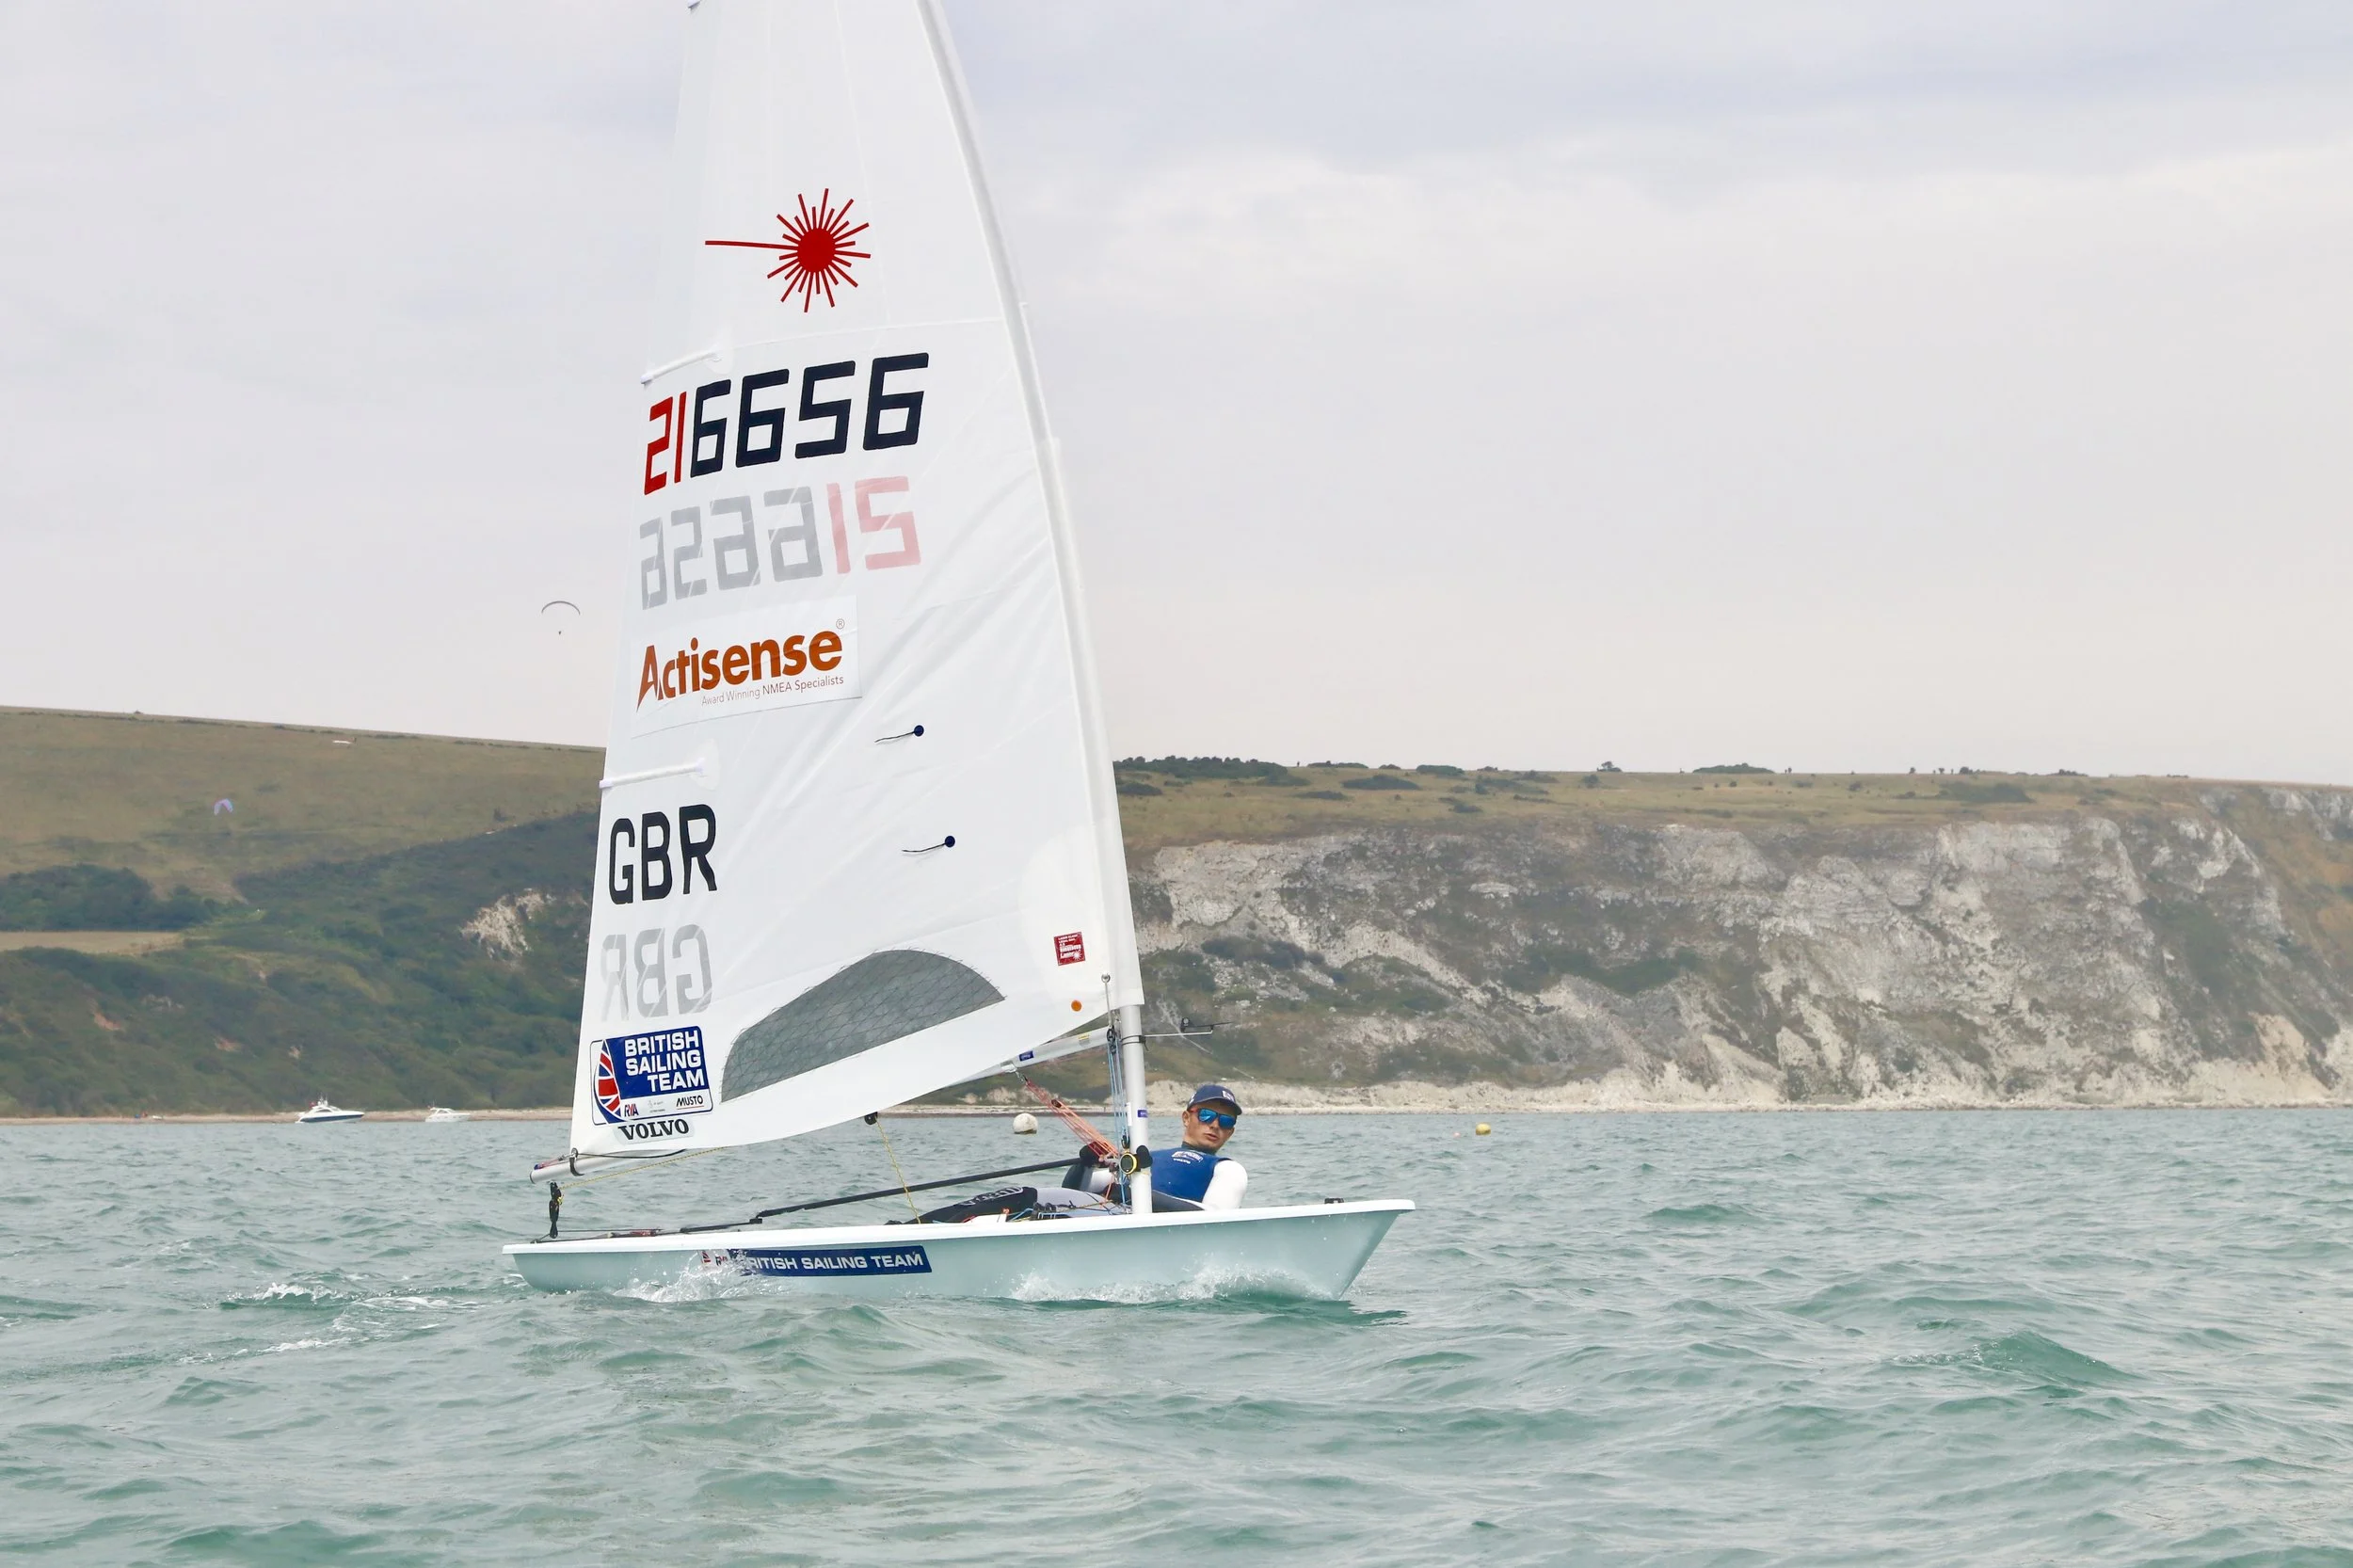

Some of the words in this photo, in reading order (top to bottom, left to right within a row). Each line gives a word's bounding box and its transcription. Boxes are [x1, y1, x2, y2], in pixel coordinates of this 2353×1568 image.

[644, 352, 929, 495] 216656
[701, 693, 725, 706] Award
[726, 688, 760, 701] Winning
[762, 681, 792, 695] NMEA
[794, 676, 844, 693] Specialists
[608, 803, 717, 904] GBR
[624, 1030, 699, 1057] BRITISH
[625, 1049, 700, 1077] SAILING
[647, 1068, 705, 1093] TEAM
[624, 1103, 639, 1117] RYA
[676, 1095, 704, 1107] MUSTO
[617, 1118, 690, 1141] VOLVO
[744, 1256, 798, 1270] RITISH
[803, 1256, 868, 1271] SAILING
[871, 1253, 924, 1268] TEAM
